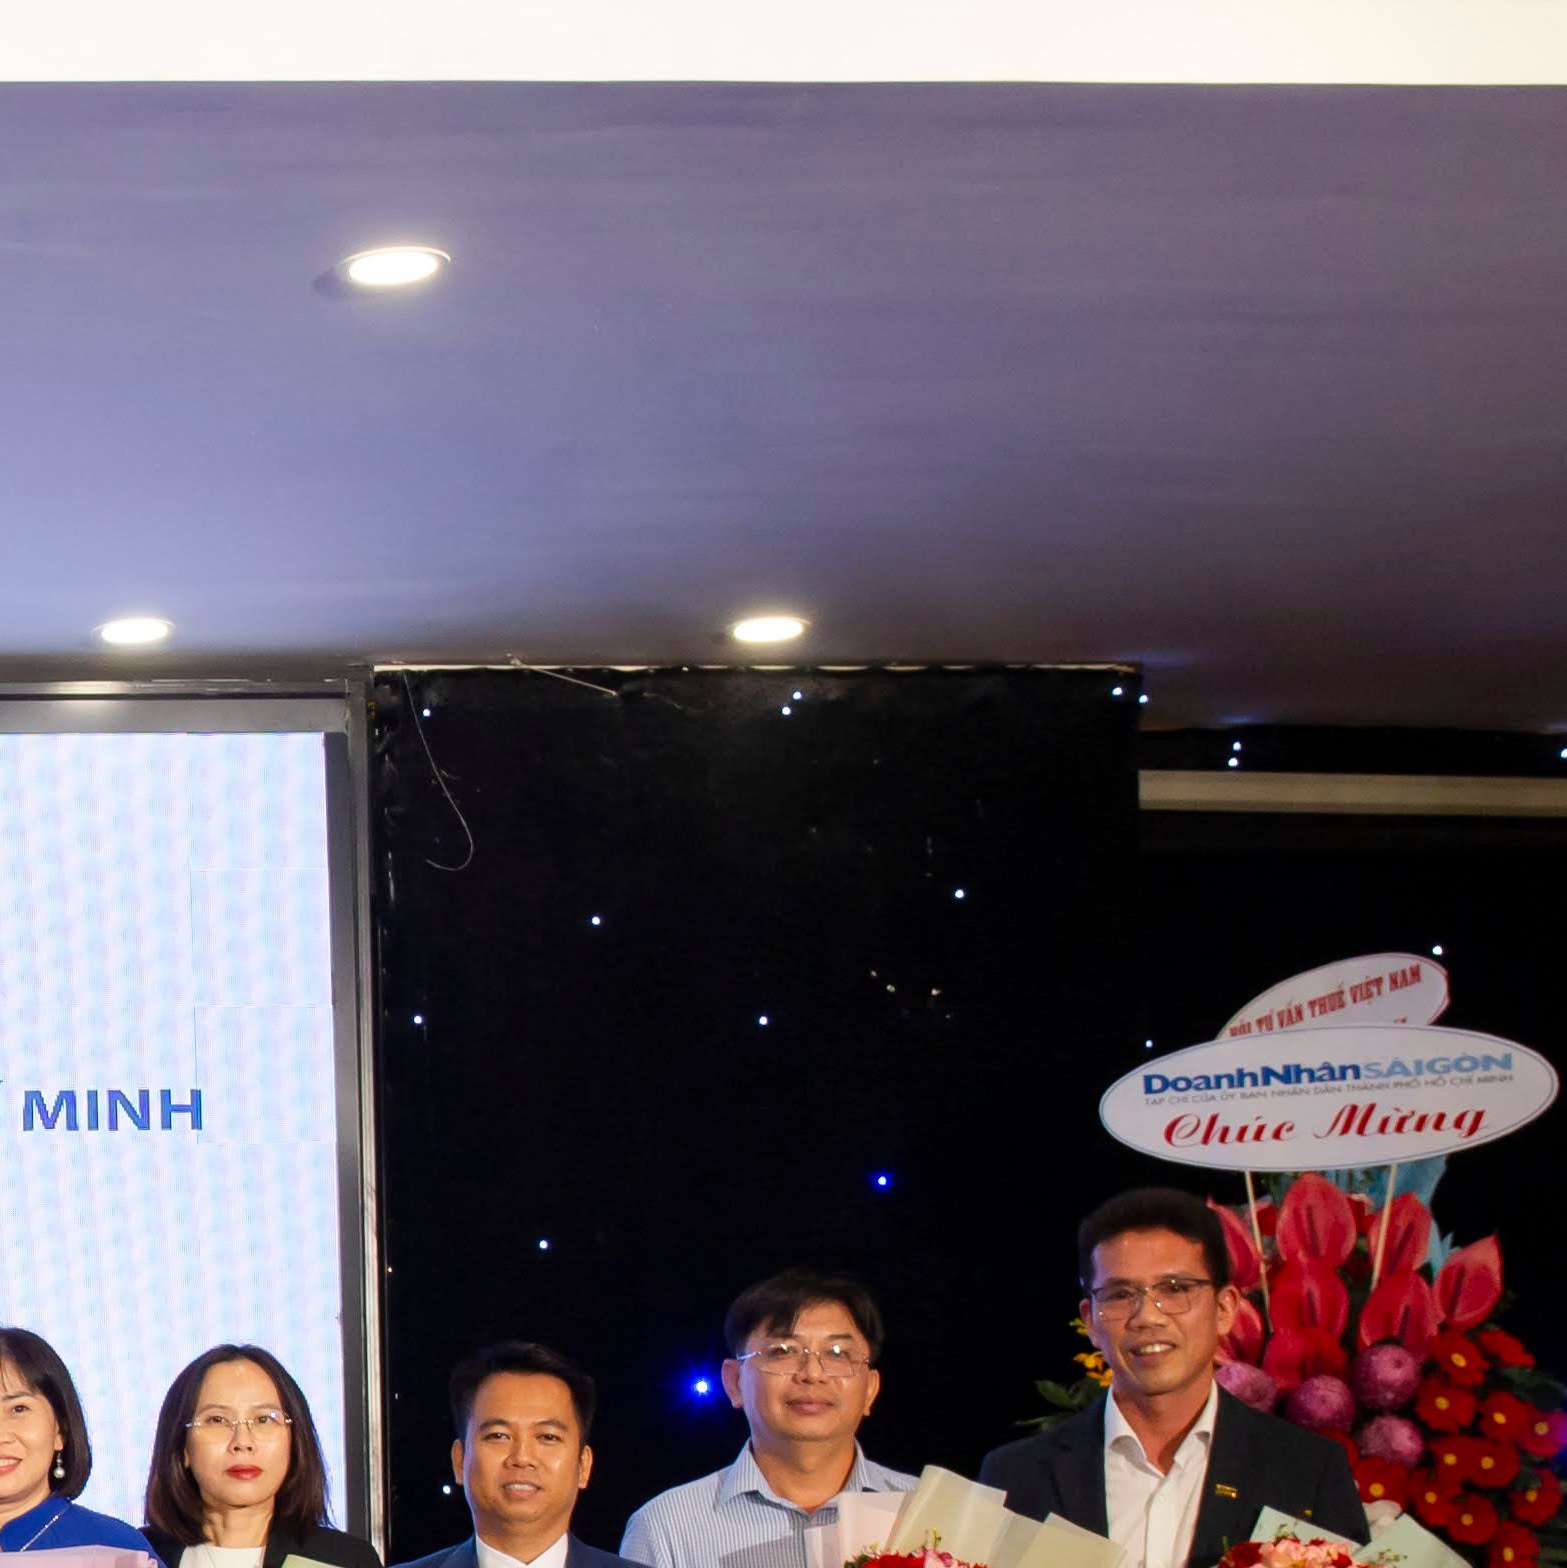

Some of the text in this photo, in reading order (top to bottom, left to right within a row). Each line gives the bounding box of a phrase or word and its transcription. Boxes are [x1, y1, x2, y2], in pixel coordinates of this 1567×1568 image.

[1389, 964, 1422, 991] NAM
[22, 1088, 203, 1132] MINH
[1163, 1101, 1489, 1148] Chúc Mừng
